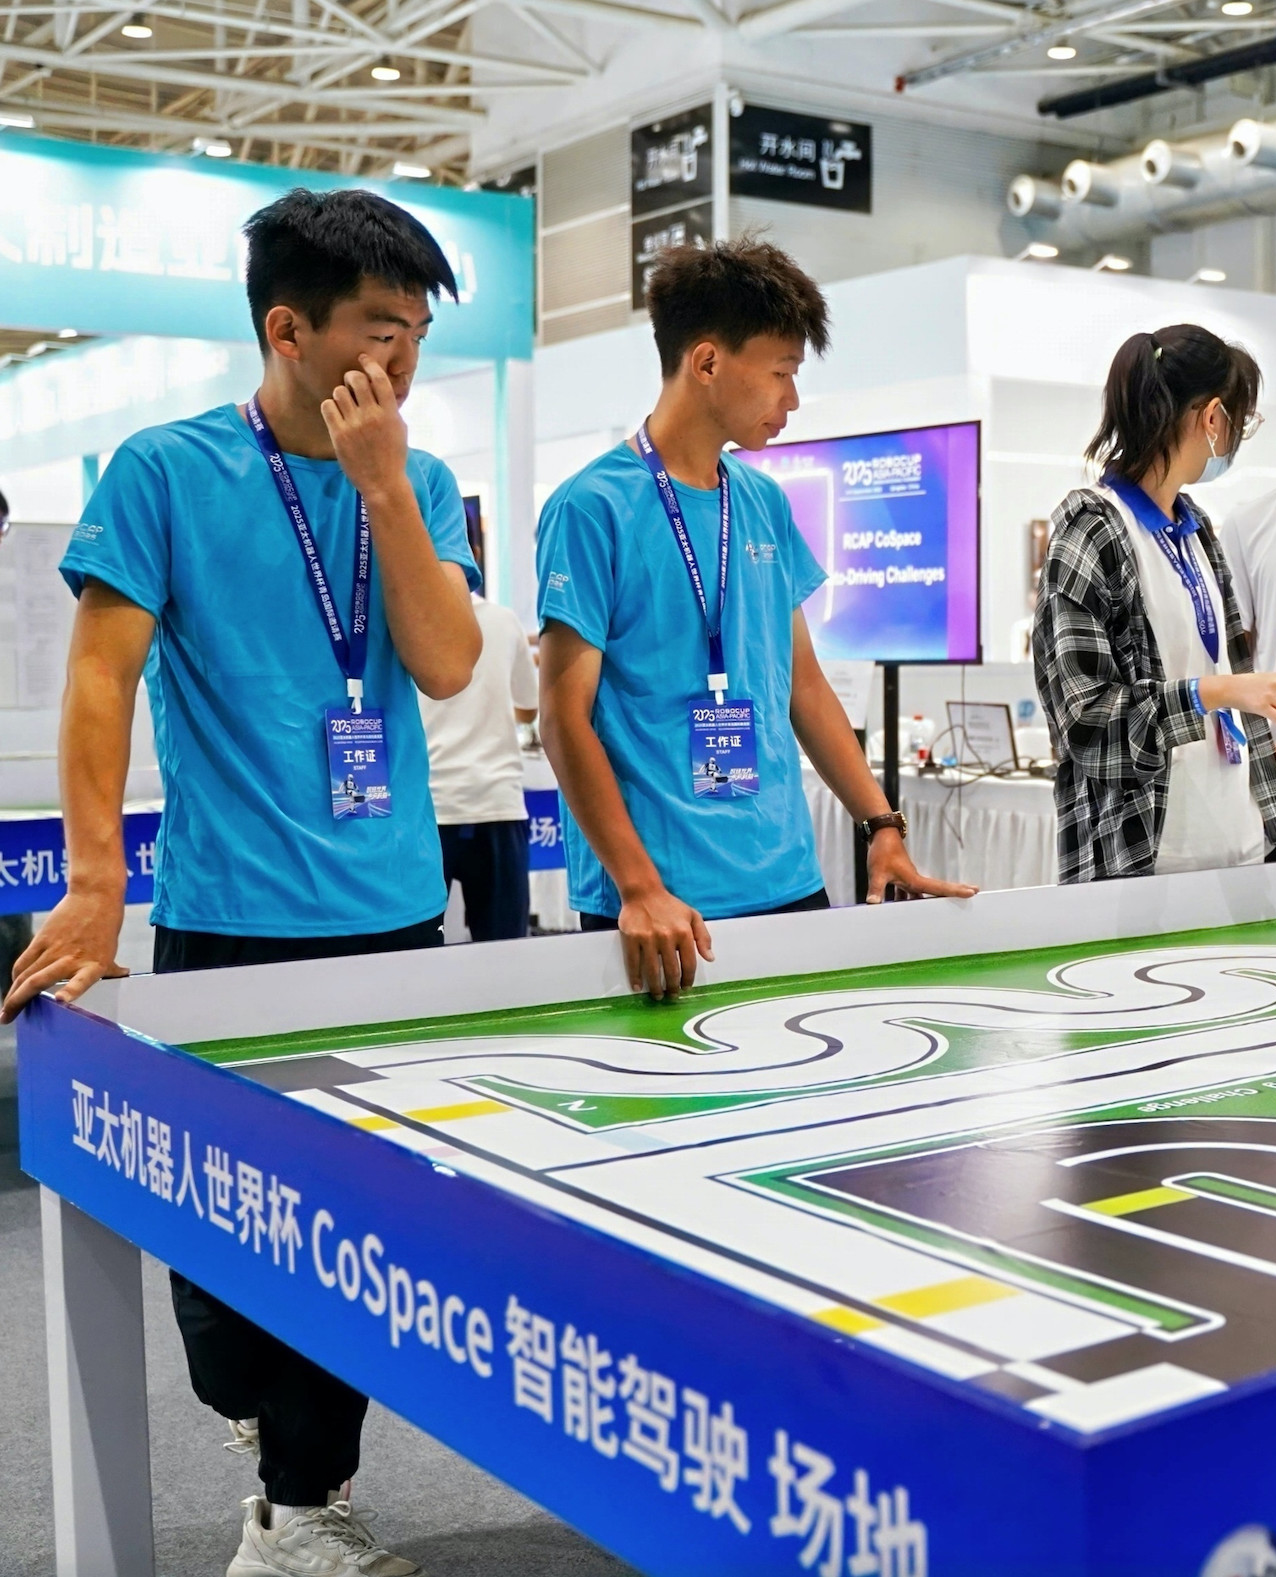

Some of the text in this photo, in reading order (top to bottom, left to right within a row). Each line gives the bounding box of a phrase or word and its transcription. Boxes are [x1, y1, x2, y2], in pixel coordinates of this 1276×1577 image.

[759, 132, 816, 163] 开水间
[786, 164, 816, 181] Room
[76, 523, 103, 534] CAP
[843, 530, 922, 550] RCAP CoSpace
[886, 565, 945, 586] Challenges
[705, 735, 742, 748] 工作证
[343, 749, 377, 763] 工作证
[1137, 1086, 1259, 1114] Challenge
[71, 1077, 928, 1577] 亚太机器人世界杯 CoSpace 智能驾驶 场地
